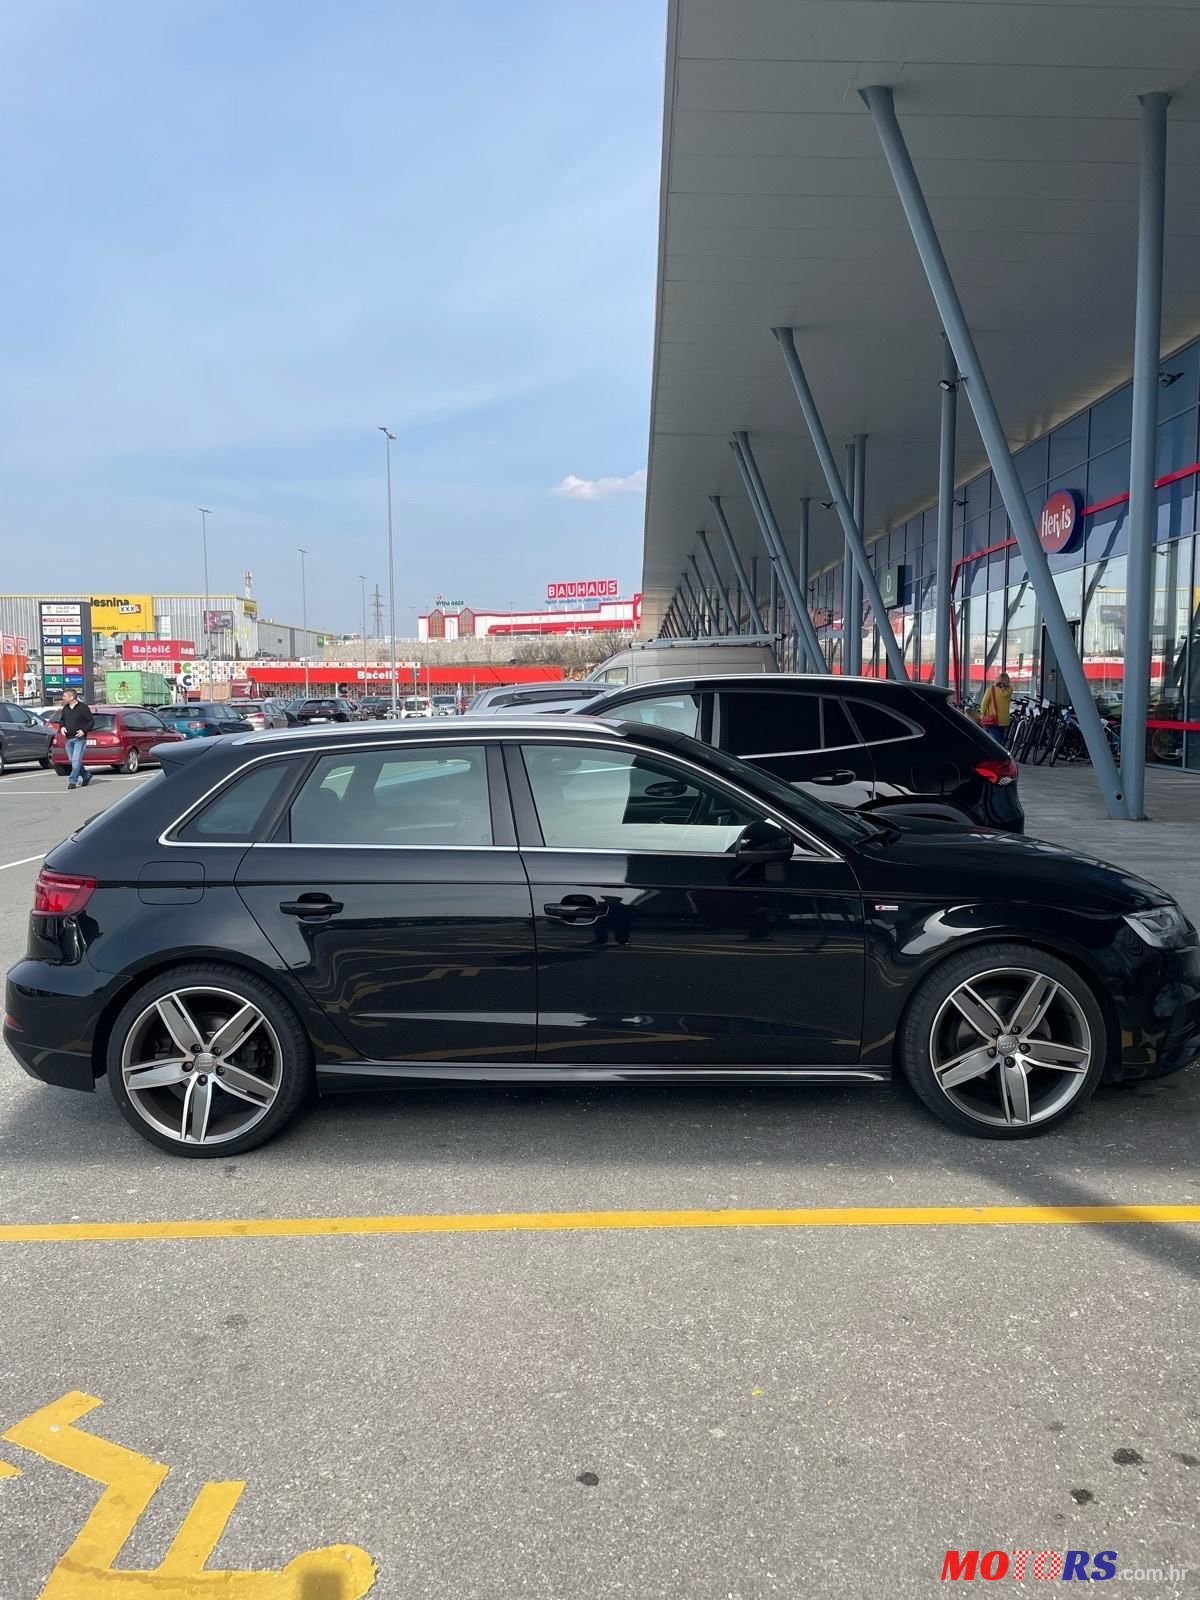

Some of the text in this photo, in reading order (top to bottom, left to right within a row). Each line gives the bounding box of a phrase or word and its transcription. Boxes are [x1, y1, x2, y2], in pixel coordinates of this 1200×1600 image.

[1041, 504, 1072, 538] Hervis
[547, 580, 618, 598] BAUHAUS
[90, 597, 130, 607] lesnina
[131, 645, 171, 654] Bačelić
[357, 670, 400, 680] Bačelić
